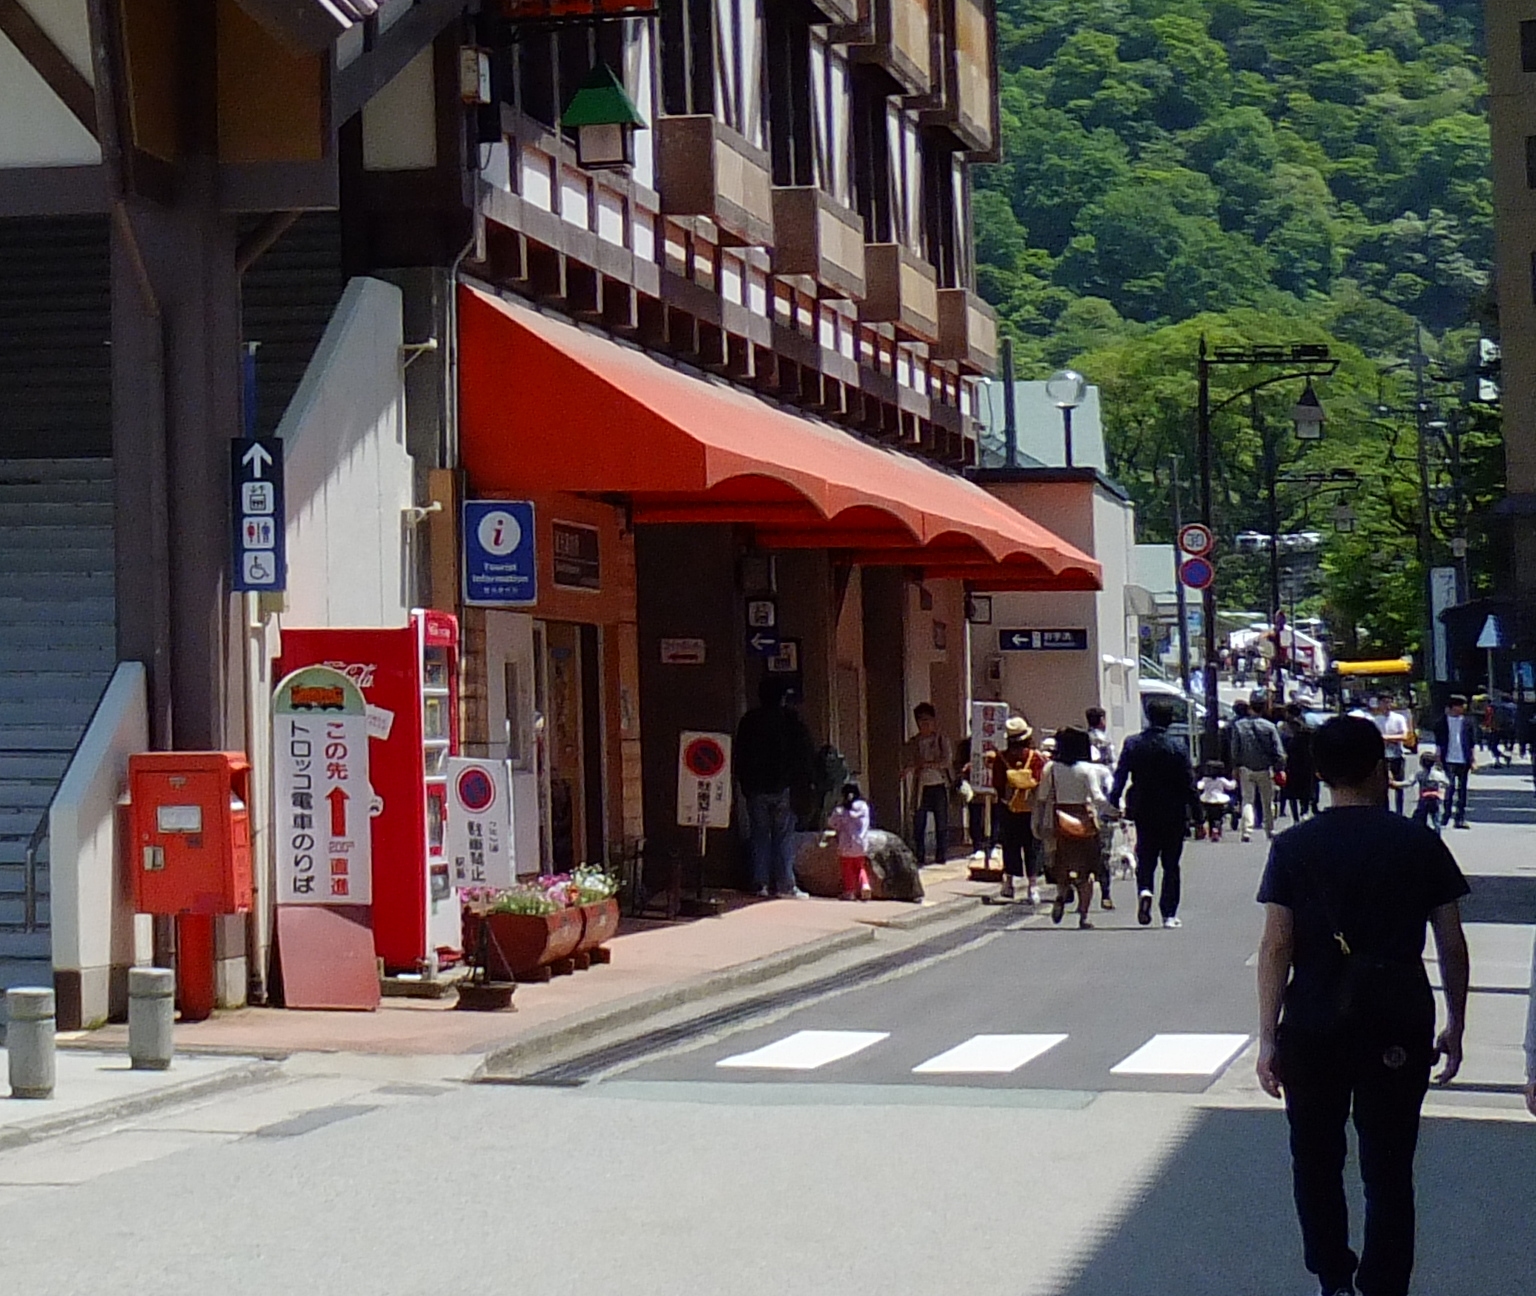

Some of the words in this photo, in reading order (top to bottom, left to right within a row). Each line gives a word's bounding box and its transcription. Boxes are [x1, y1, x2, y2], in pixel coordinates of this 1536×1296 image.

[1187, 533, 1205, 547] 30
[324, 721, 349, 780] この先
[290, 720, 315, 894] トロッコ電車のりば
[330, 857, 349, 896] 直進
